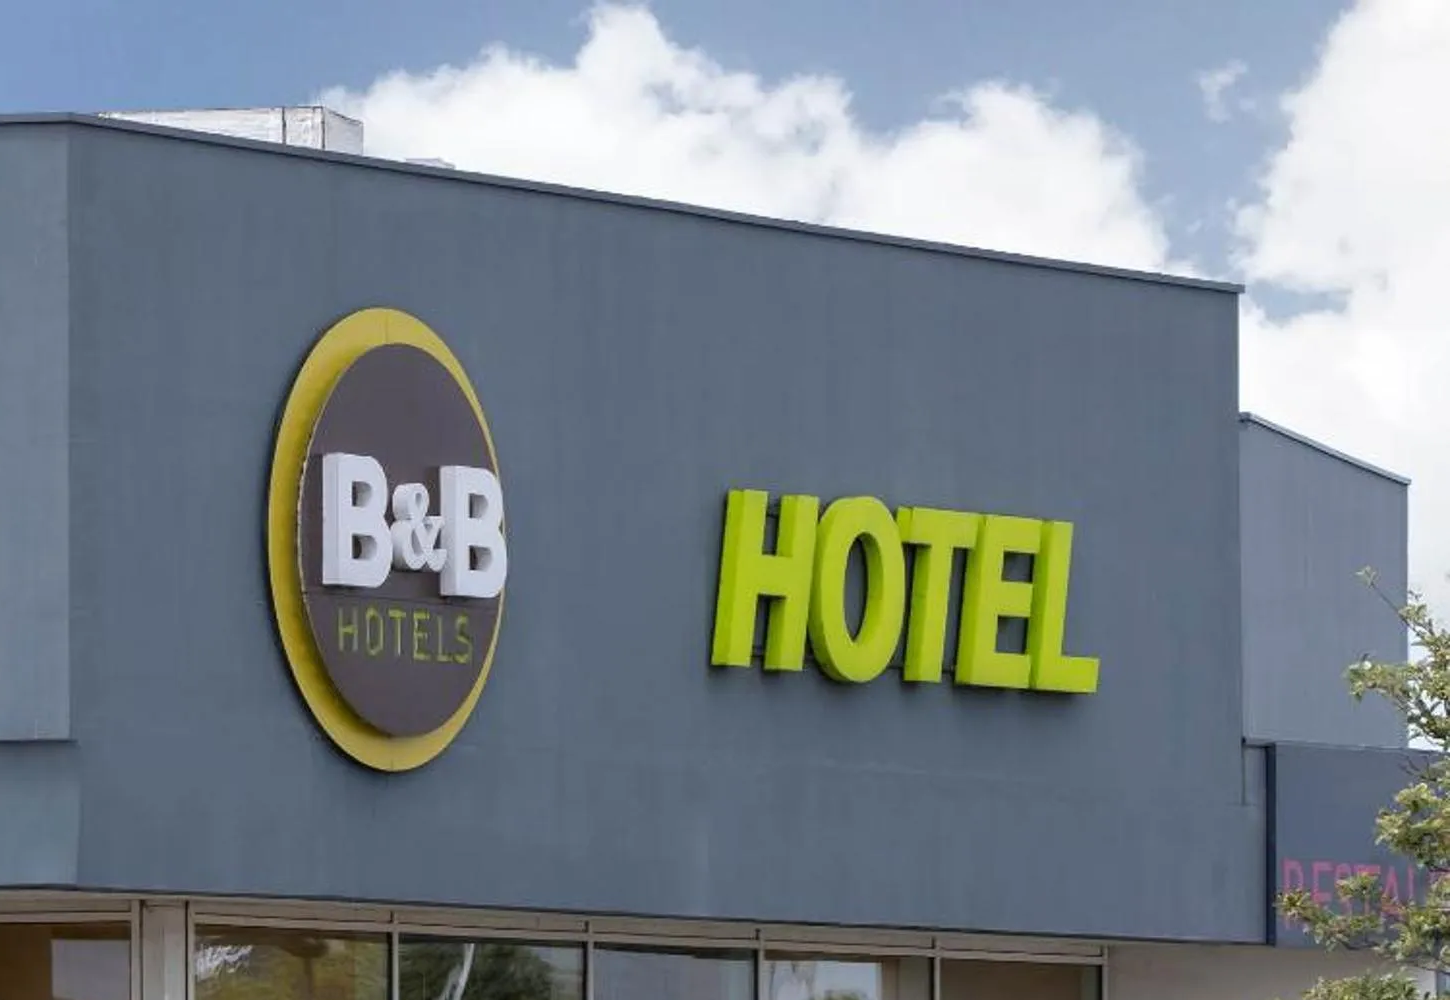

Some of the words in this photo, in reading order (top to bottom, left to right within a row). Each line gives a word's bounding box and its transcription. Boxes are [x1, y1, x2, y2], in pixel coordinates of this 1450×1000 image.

[322, 452, 508, 599] B&B
[710, 489, 1100, 694] HOTEL
[337, 605, 474, 665] HOTELS
